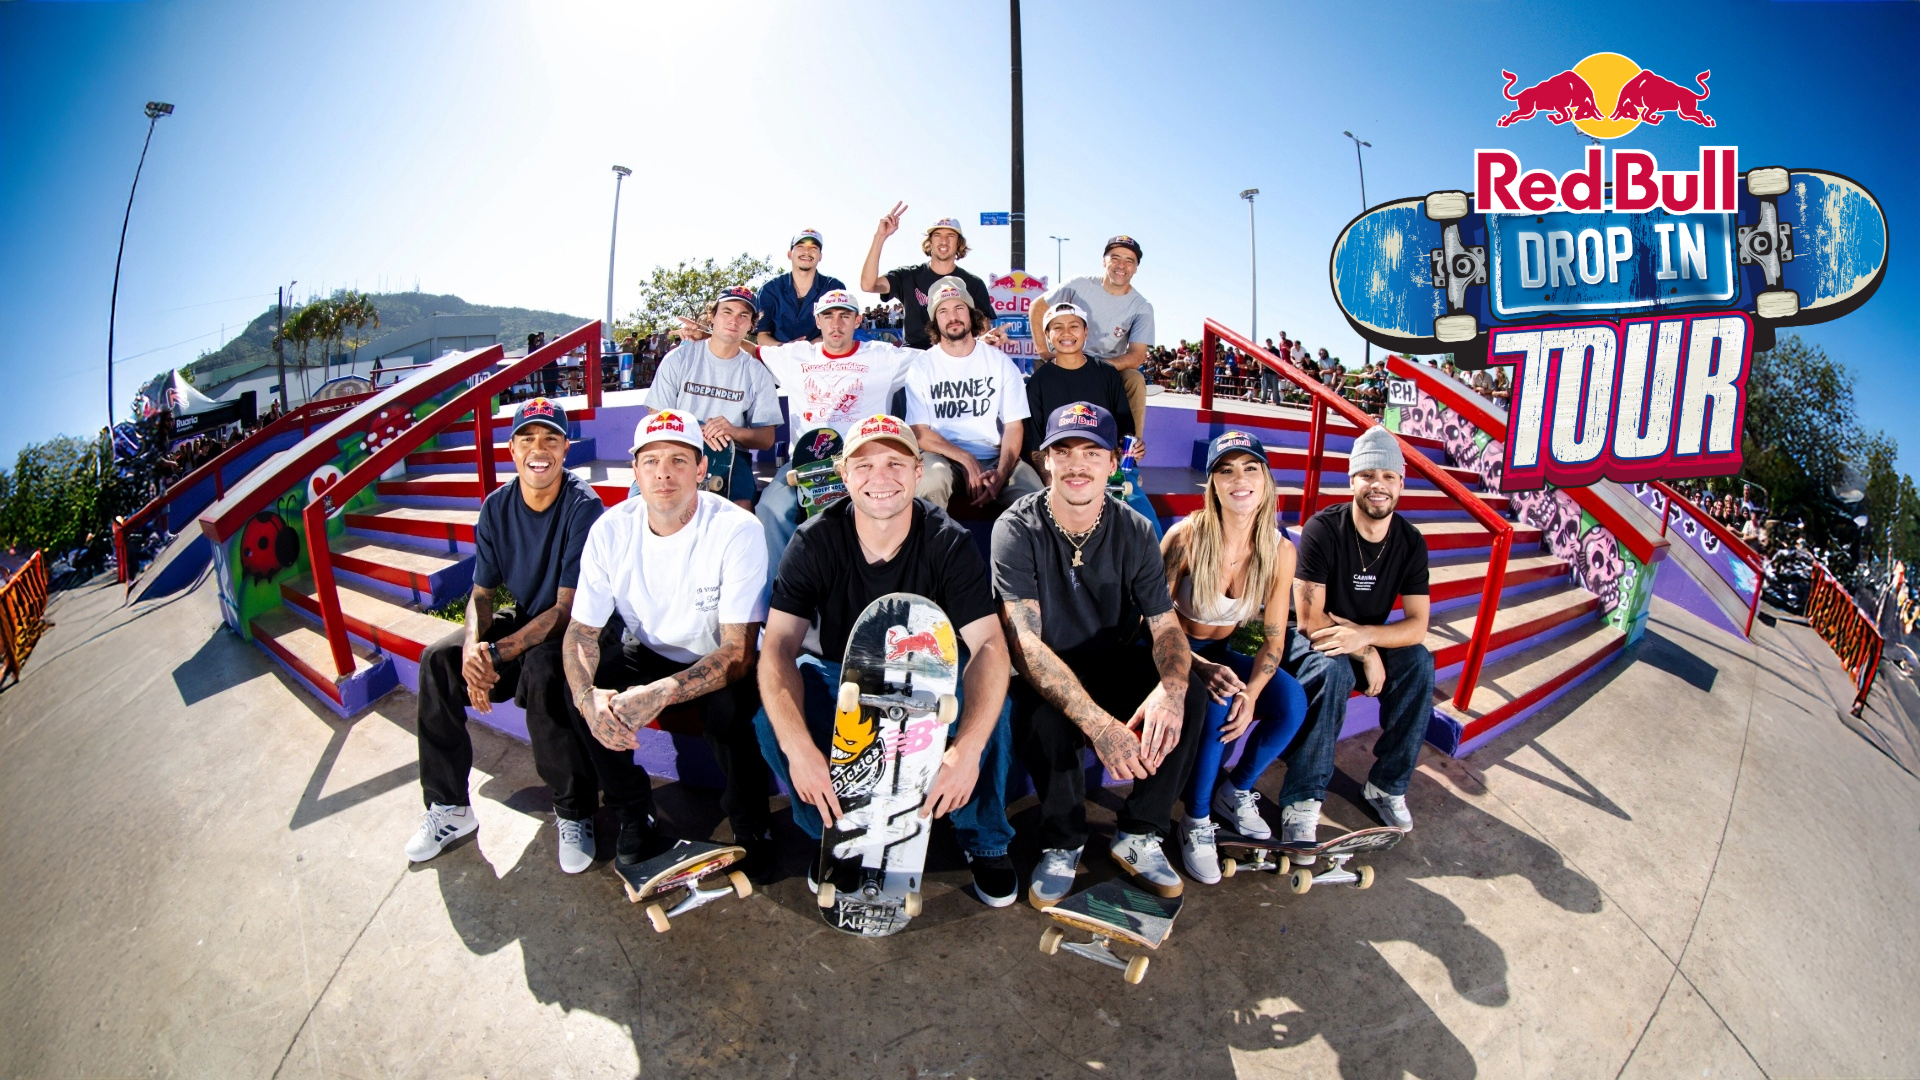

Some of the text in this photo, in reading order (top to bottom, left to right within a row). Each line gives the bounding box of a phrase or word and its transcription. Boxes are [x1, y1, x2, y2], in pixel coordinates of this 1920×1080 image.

[1000, 321, 1023, 333] DOP
[686, 383, 743, 401] INDEPENDENT
[930, 376, 996, 400] WAYNE'S
[524, 408, 538, 419] Red
[934, 398, 991, 419] WORLD
[1058, 415, 1098, 427] Red Bull
[646, 422, 684, 435] Red Bull
[860, 424, 899, 436] Red Bull
[812, 483, 847, 495] INDEPENDEN
[832, 746, 881, 794] Dickies
